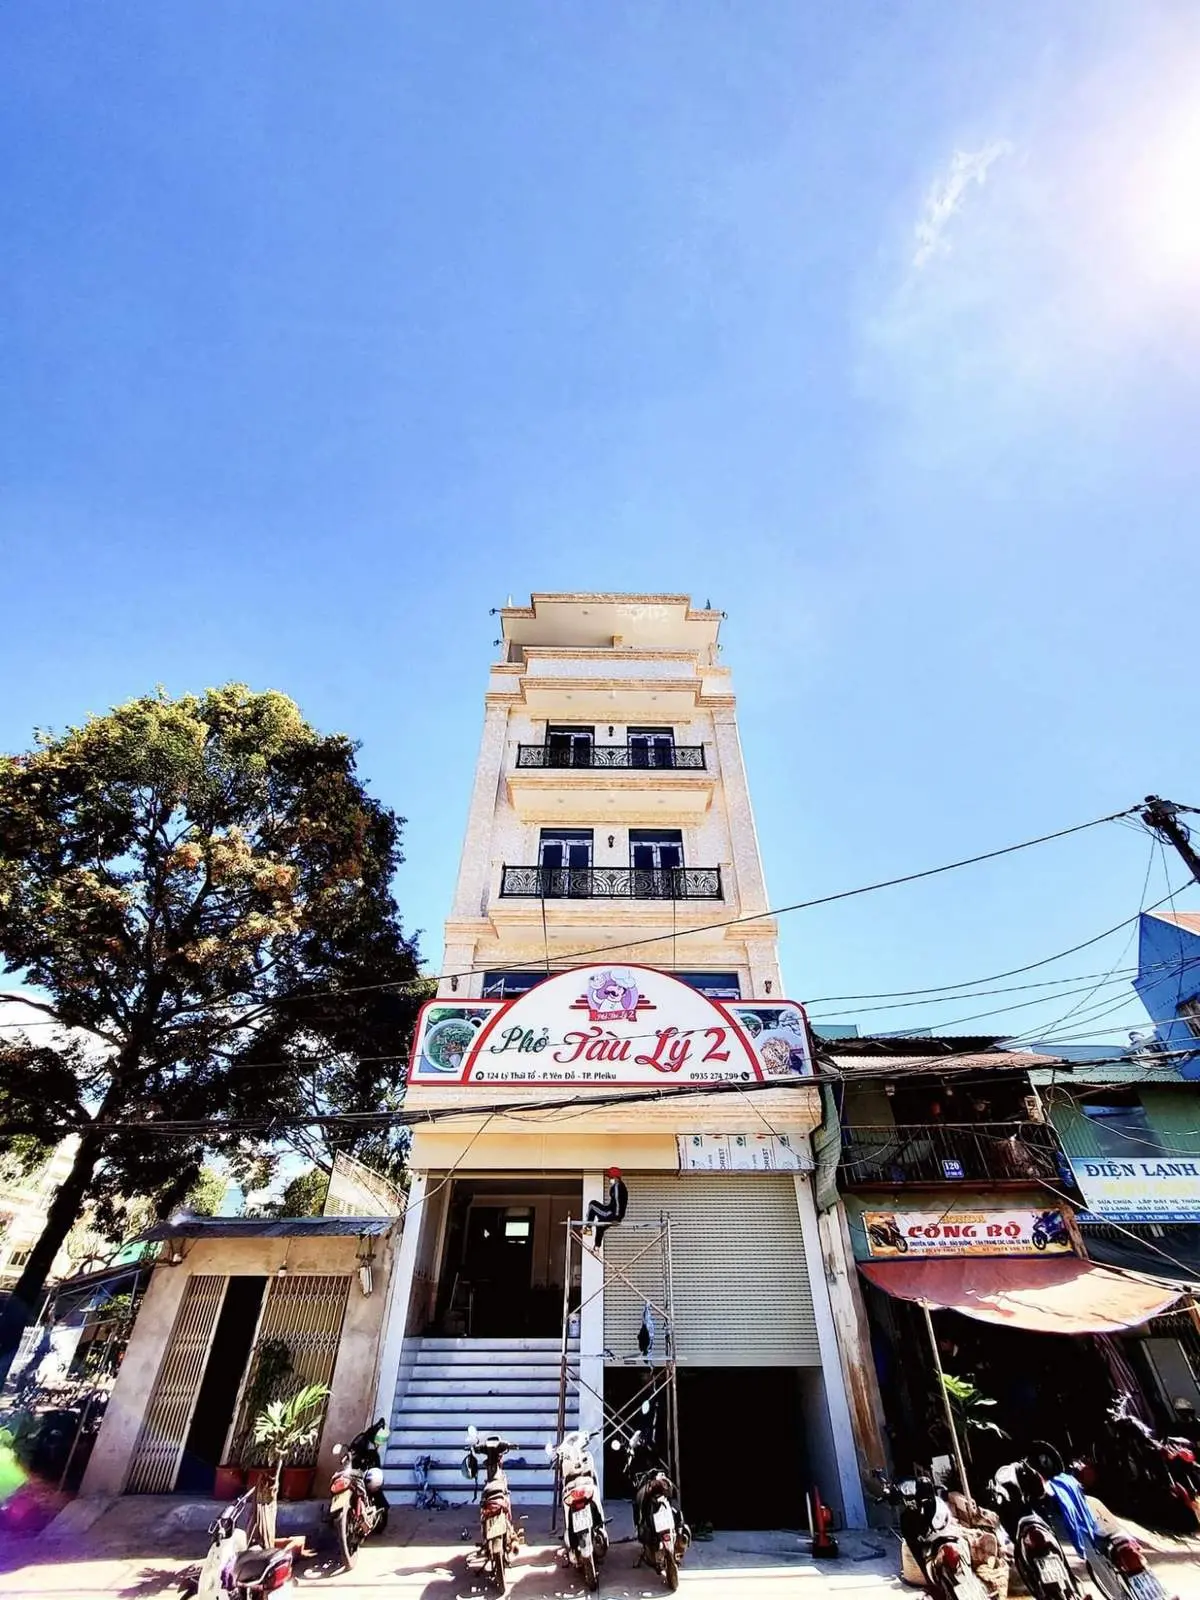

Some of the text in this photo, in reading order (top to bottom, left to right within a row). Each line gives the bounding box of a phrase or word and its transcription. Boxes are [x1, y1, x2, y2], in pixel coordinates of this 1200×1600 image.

[490, 1026, 730, 1073] Phở Tàu Lý 2
[487, 1072, 499, 1080] 124
[501, 1071, 508, 1081] Lý
[593, 1071, 617, 1080] Pleiku
[690, 1072, 708, 1080] 0935
[944, 1161, 960, 1170] 120
[1083, 1160, 1199, 1180] ĐIỆN LẠNH
[986, 1221, 1021, 1239] BỘ
